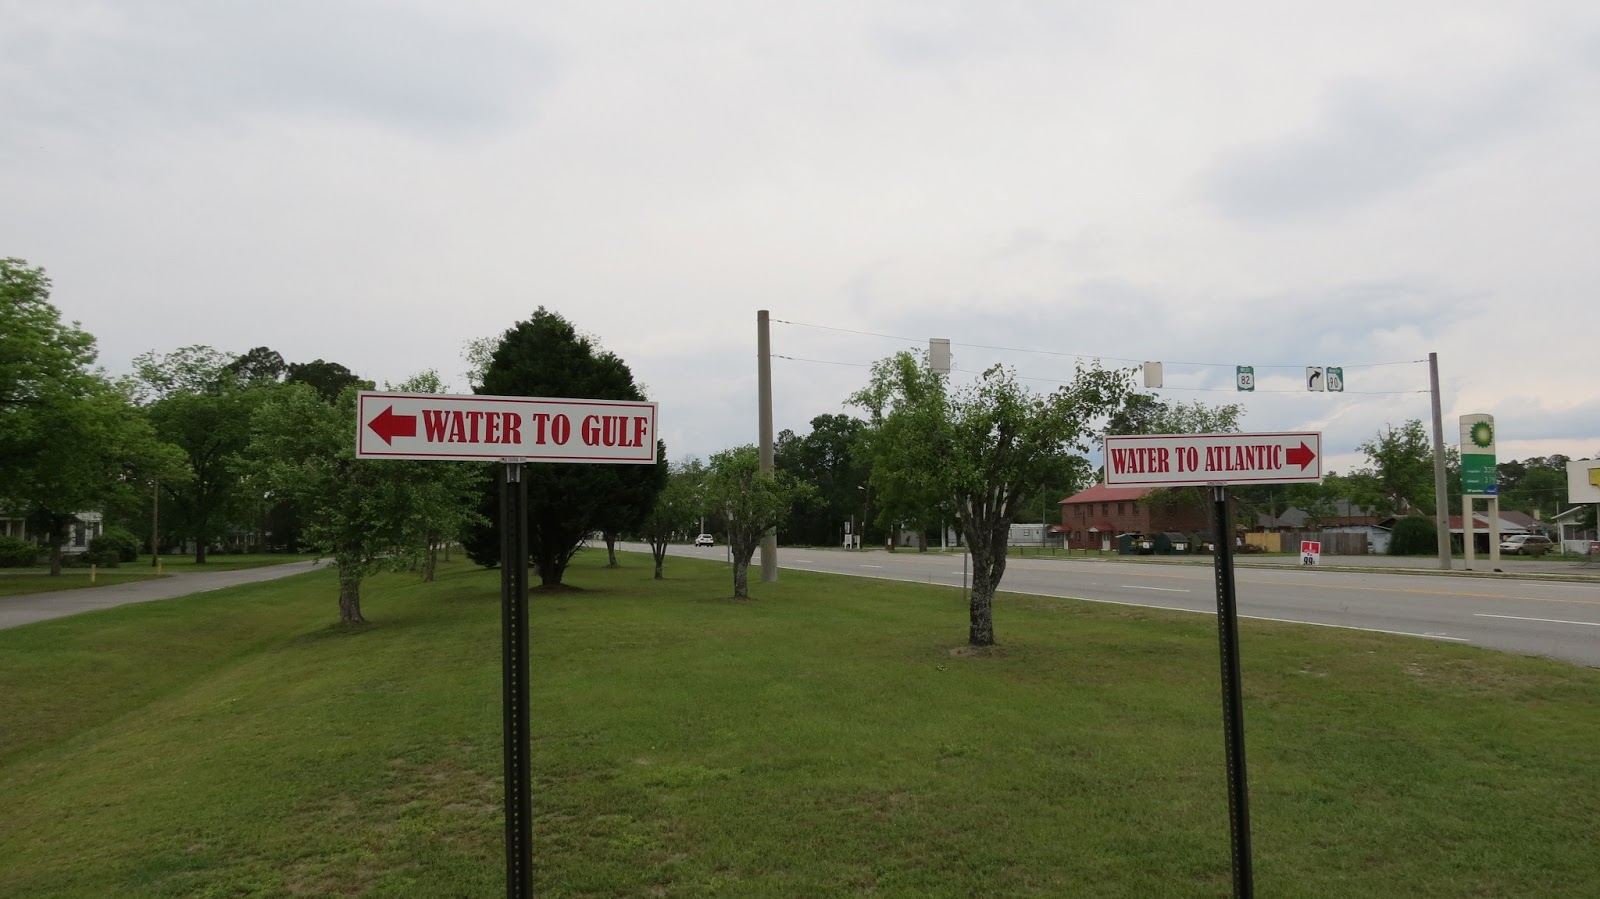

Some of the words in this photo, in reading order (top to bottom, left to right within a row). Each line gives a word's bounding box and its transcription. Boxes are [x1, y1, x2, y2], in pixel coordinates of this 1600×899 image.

[1241, 376, 1250, 384] 82
[1330, 377, 1339, 388] 90
[422, 409, 521, 443] WATER
[533, 413, 570, 445] TO
[581, 415, 647, 447] GULF
[1111, 447, 1170, 474] WATER
[1175, 446, 1199, 472] TO
[1205, 444, 1282, 471] ATLANTIC
